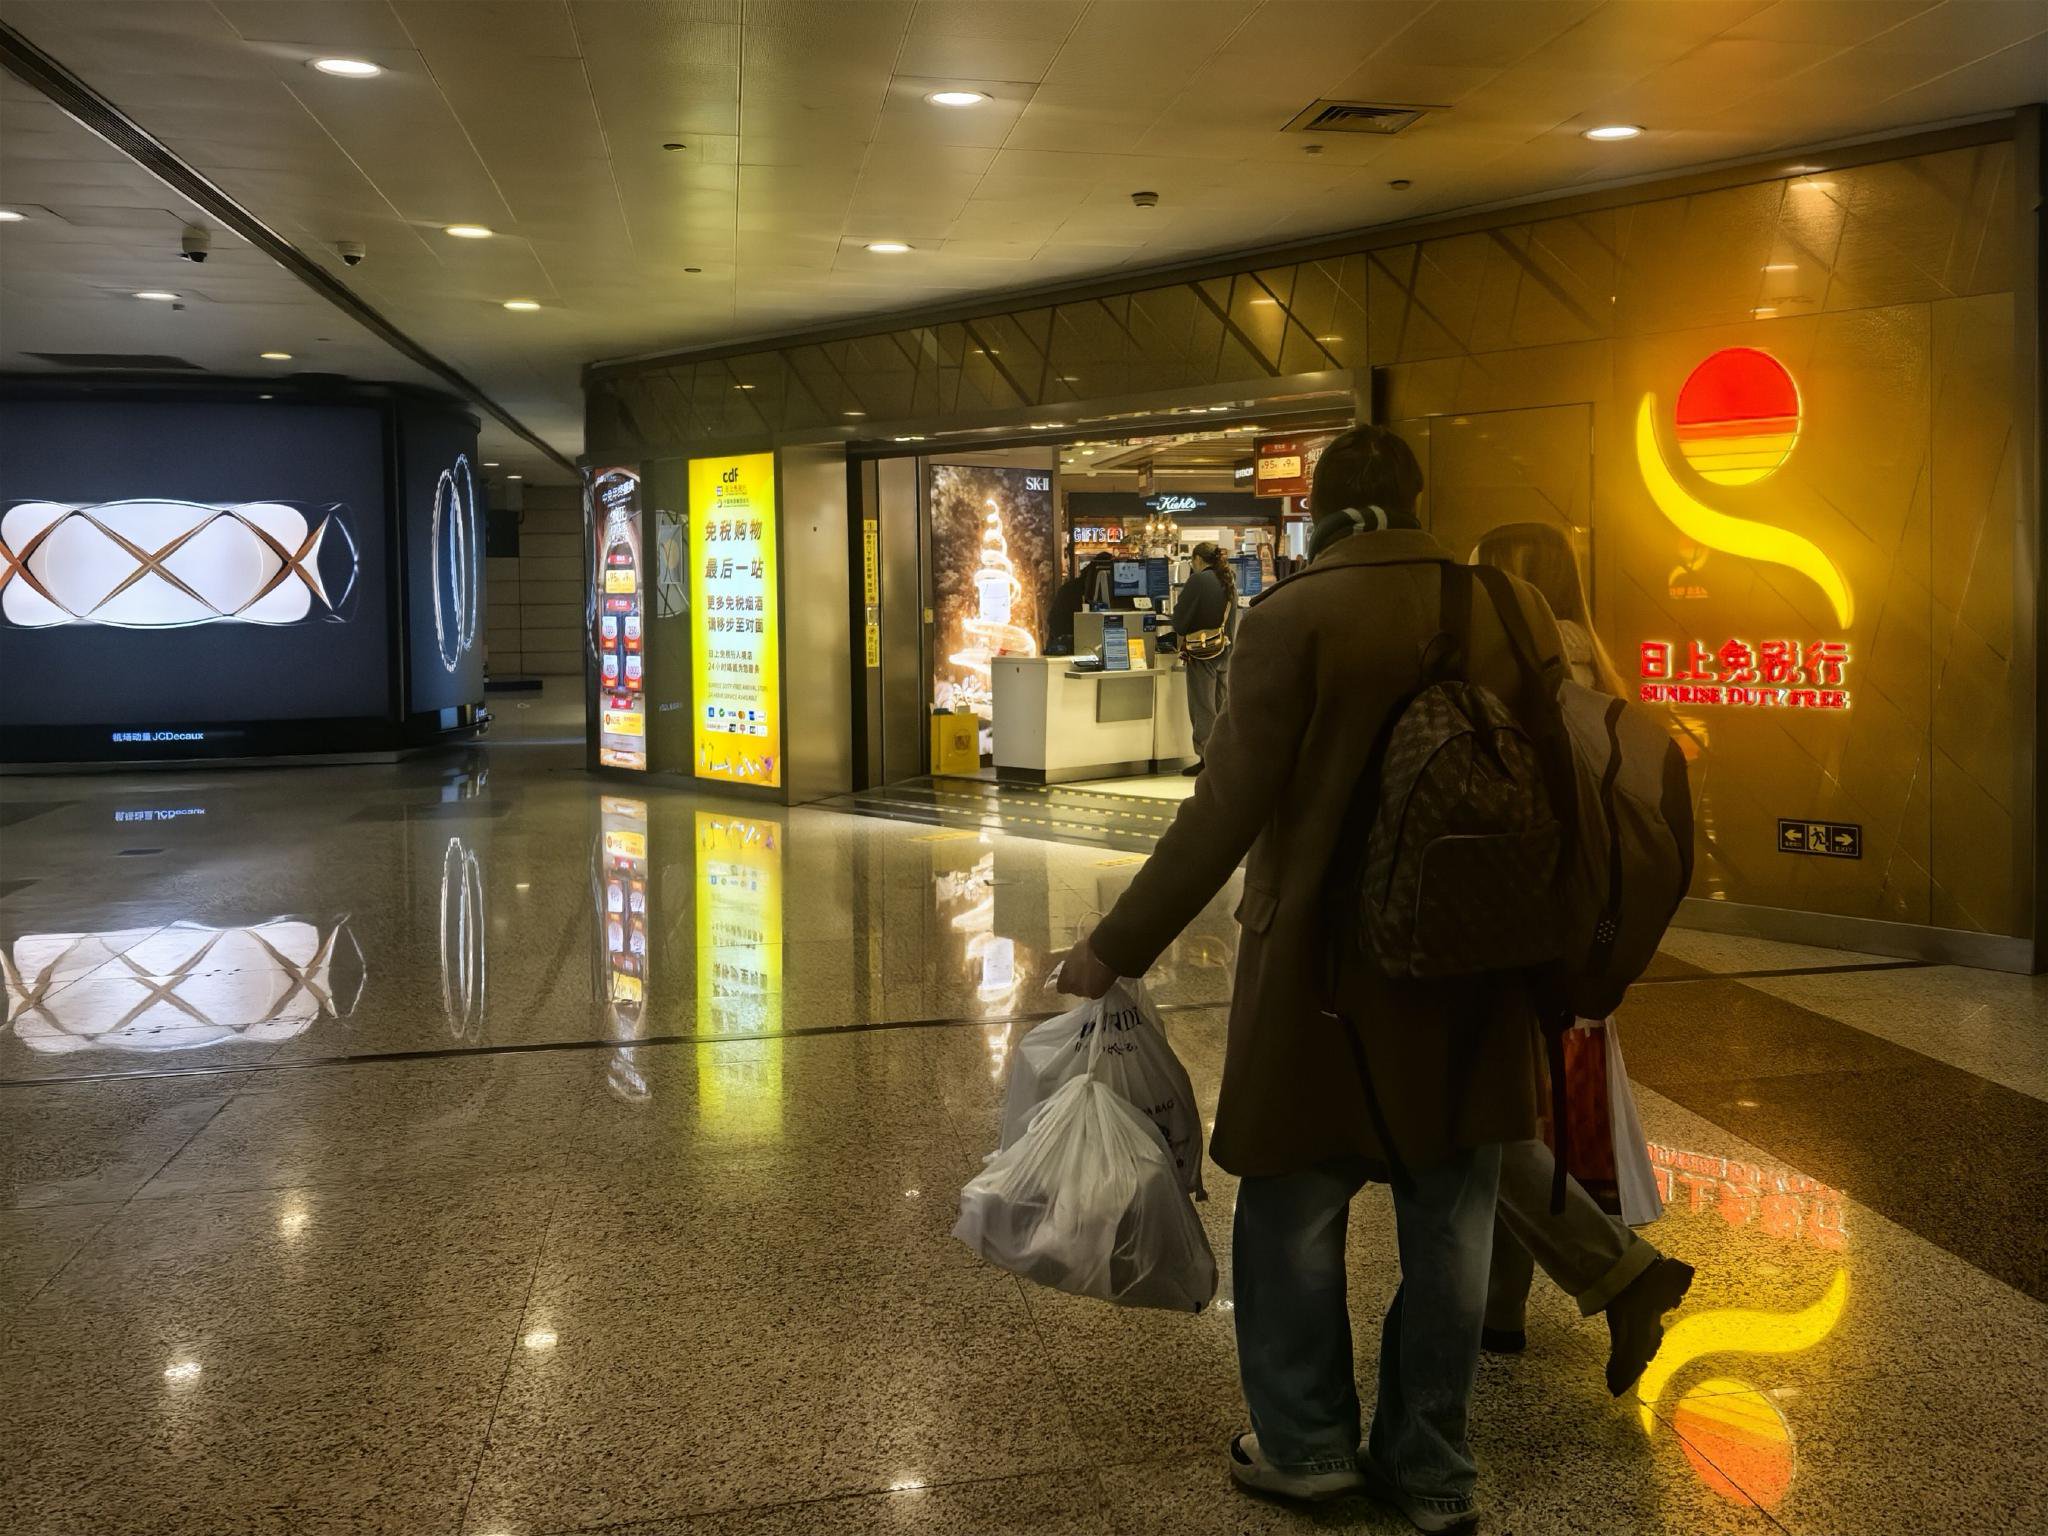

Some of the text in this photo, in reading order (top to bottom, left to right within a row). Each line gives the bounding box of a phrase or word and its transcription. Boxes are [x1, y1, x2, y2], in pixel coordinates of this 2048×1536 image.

[722, 467, 739, 483] cdf
[1025, 477, 1049, 491] SK-II
[1156, 496, 1197, 512] Kiehl's
[705, 518, 763, 541] 免税购物
[1073, 527, 1106, 543] GIFTS
[705, 557, 764, 579] 最后一站
[707, 594, 764, 611] 更多免税烟酒
[708, 617, 764, 633] 请移步至对面
[1641, 639, 1849, 685] 日上免税行
[1640, 684, 1850, 709] SUNRISE DUTY FREE
[152, 732, 204, 741] JCDecaux
